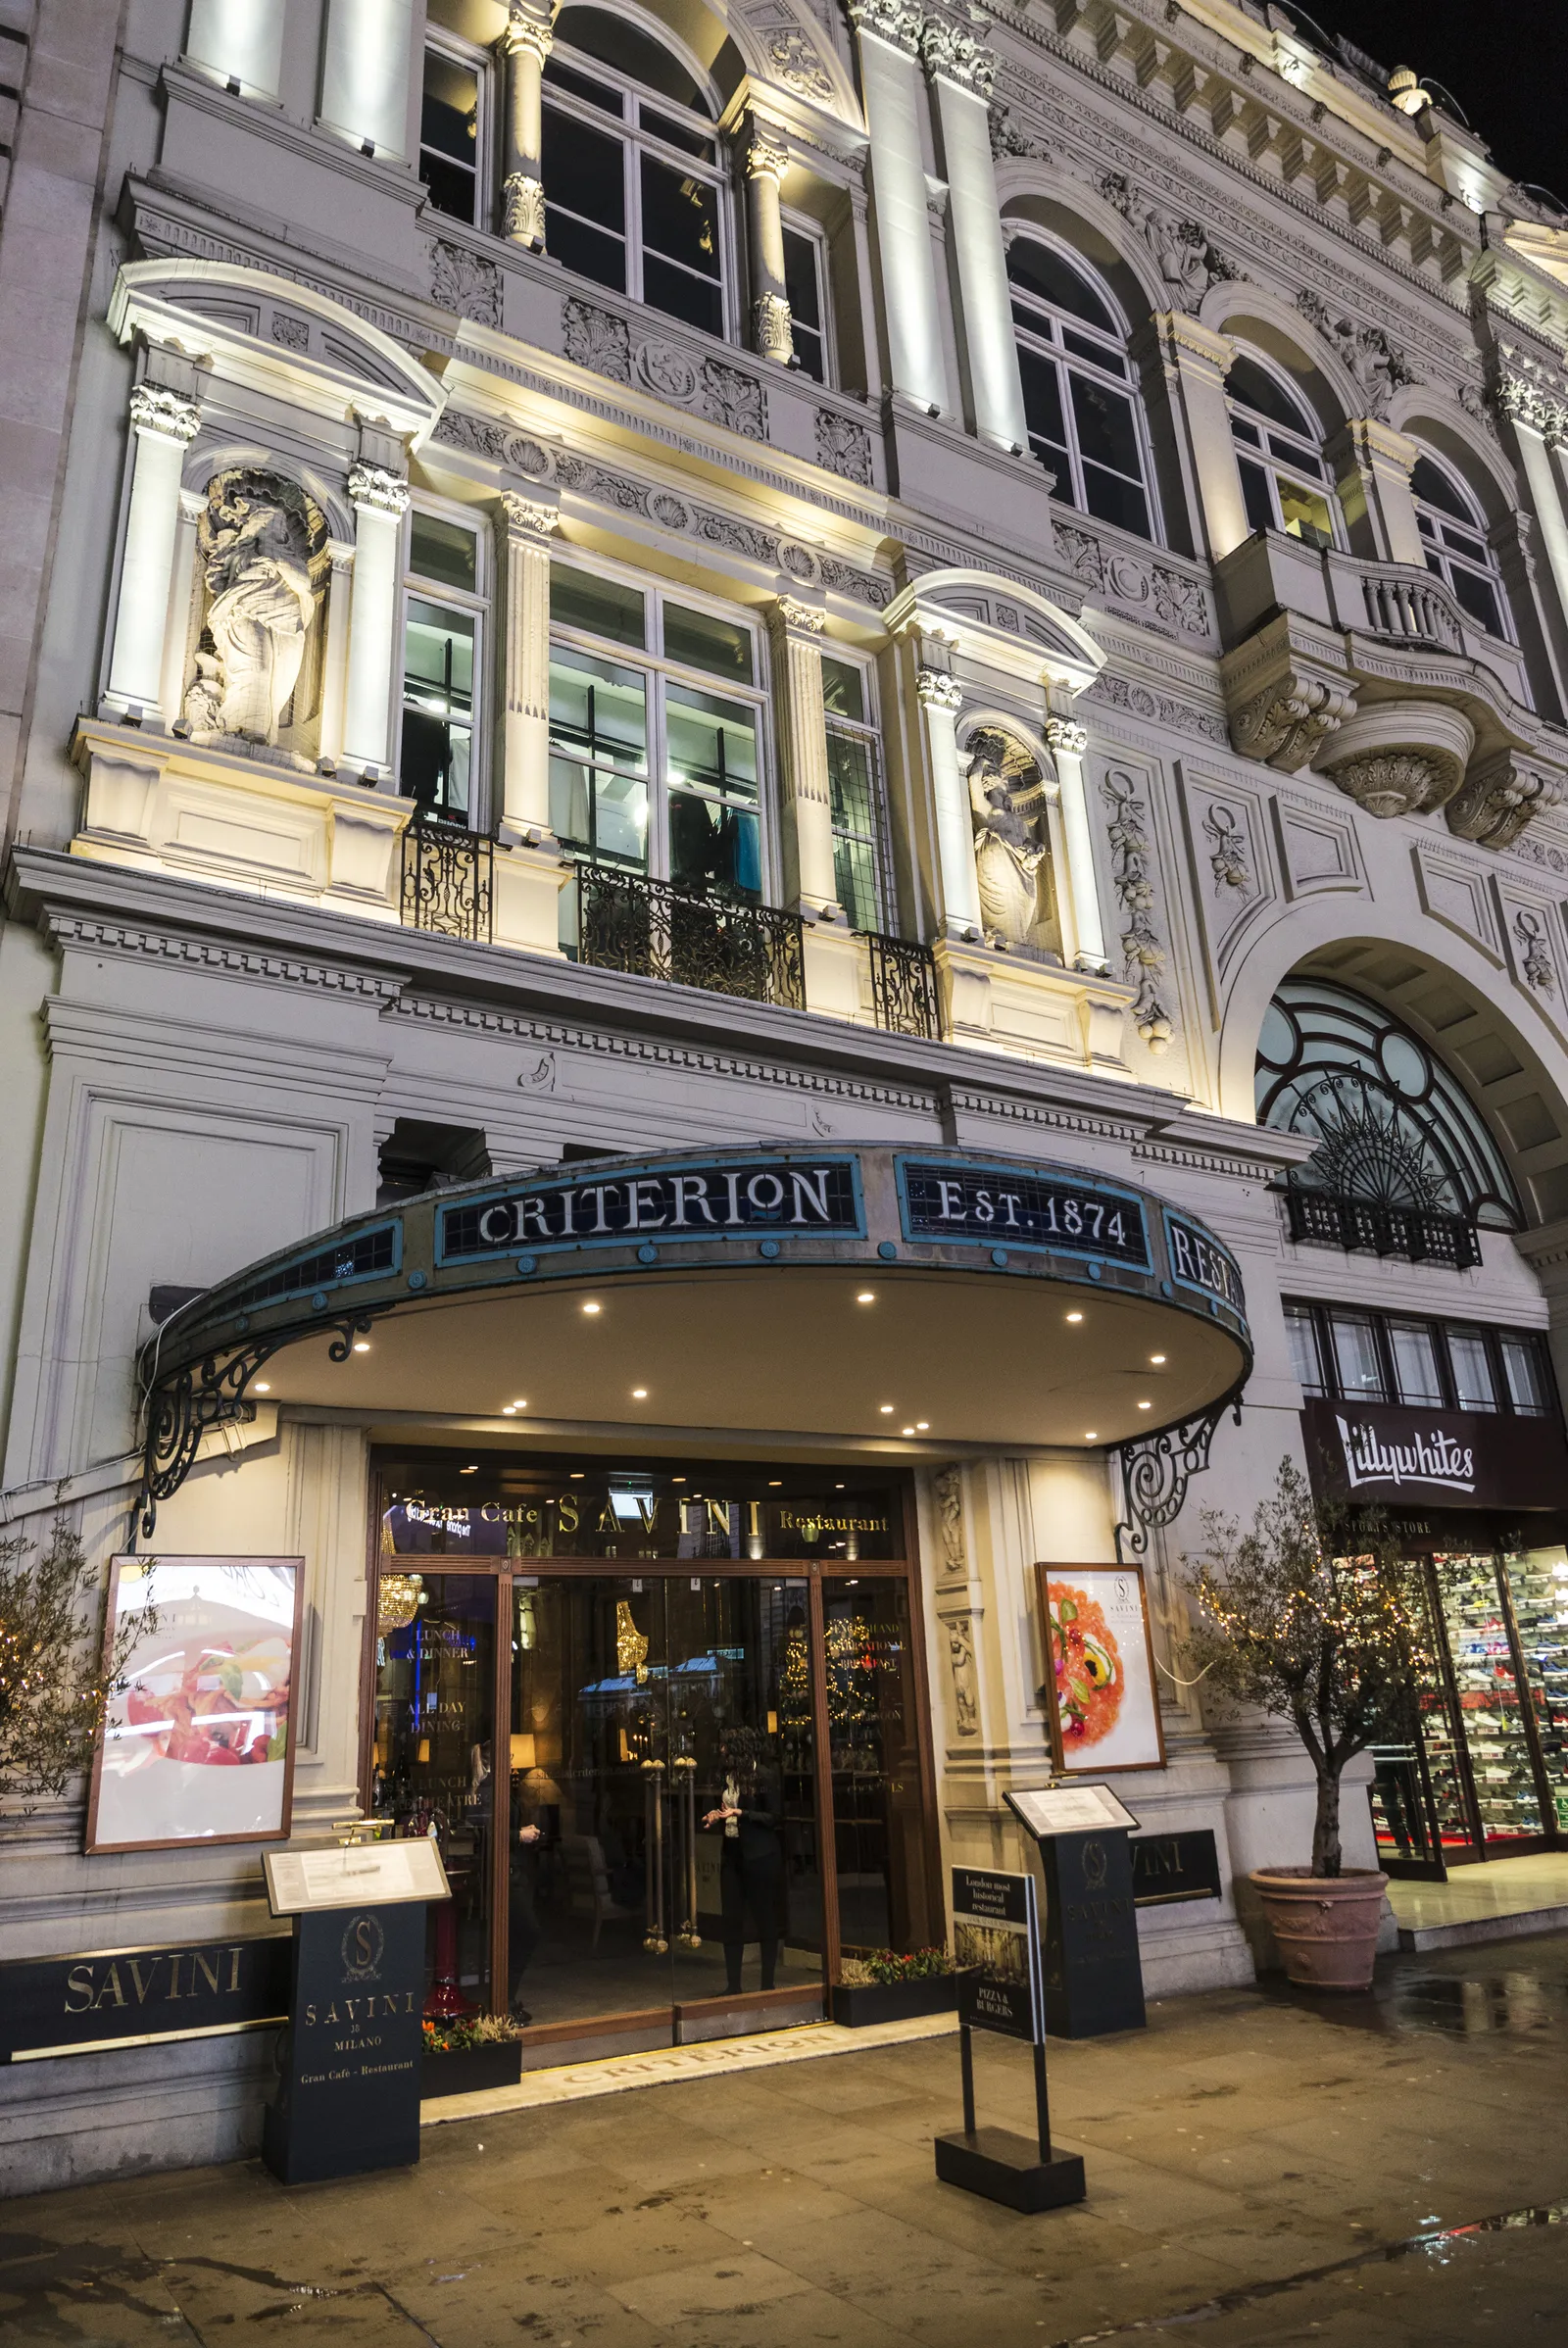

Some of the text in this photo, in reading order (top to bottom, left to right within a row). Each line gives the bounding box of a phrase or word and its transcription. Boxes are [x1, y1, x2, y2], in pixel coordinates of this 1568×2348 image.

[479, 1169, 832, 1243] CRITERION
[936, 1180, 1127, 1247] EST. 1874
[1335, 1414, 1476, 1492] Lillywhites
[406, 1499, 469, 1522] Gran
[480, 1501, 538, 1524] Cafe
[559, 1492, 762, 1537] SAVINI
[780, 1510, 890, 1533] Restaurant
[1395, 1520, 1432, 1535] STORE
[1109, 1604, 1139, 1613] SAVINI
[416, 1629, 461, 1641] LUNCH
[406, 1647, 469, 1660] & DINNER
[406, 1701, 466, 1715] ALL DAY
[411, 1719, 462, 1734] DINING
[418, 1776, 466, 1790] LUNCH
[965, 1875, 1011, 1892] London most
[972, 1887, 1004, 1904] historical
[971, 1902, 1007, 1917] restaurant
[1066, 1897, 1132, 1922] SAVINI
[356, 1921, 371, 1966] S
[64, 1947, 243, 2014] SAVINI
[978, 1986, 1009, 2005] PIZZA &
[305, 1991, 416, 2027] SAVINI
[976, 1998, 1013, 2017] BURGERS
[333, 2035, 382, 2053] MILANO
[563, 2033, 832, 2084] CRITERION
[301, 2074, 326, 2085] Gran
[361, 2059, 415, 2077] Restaurant
